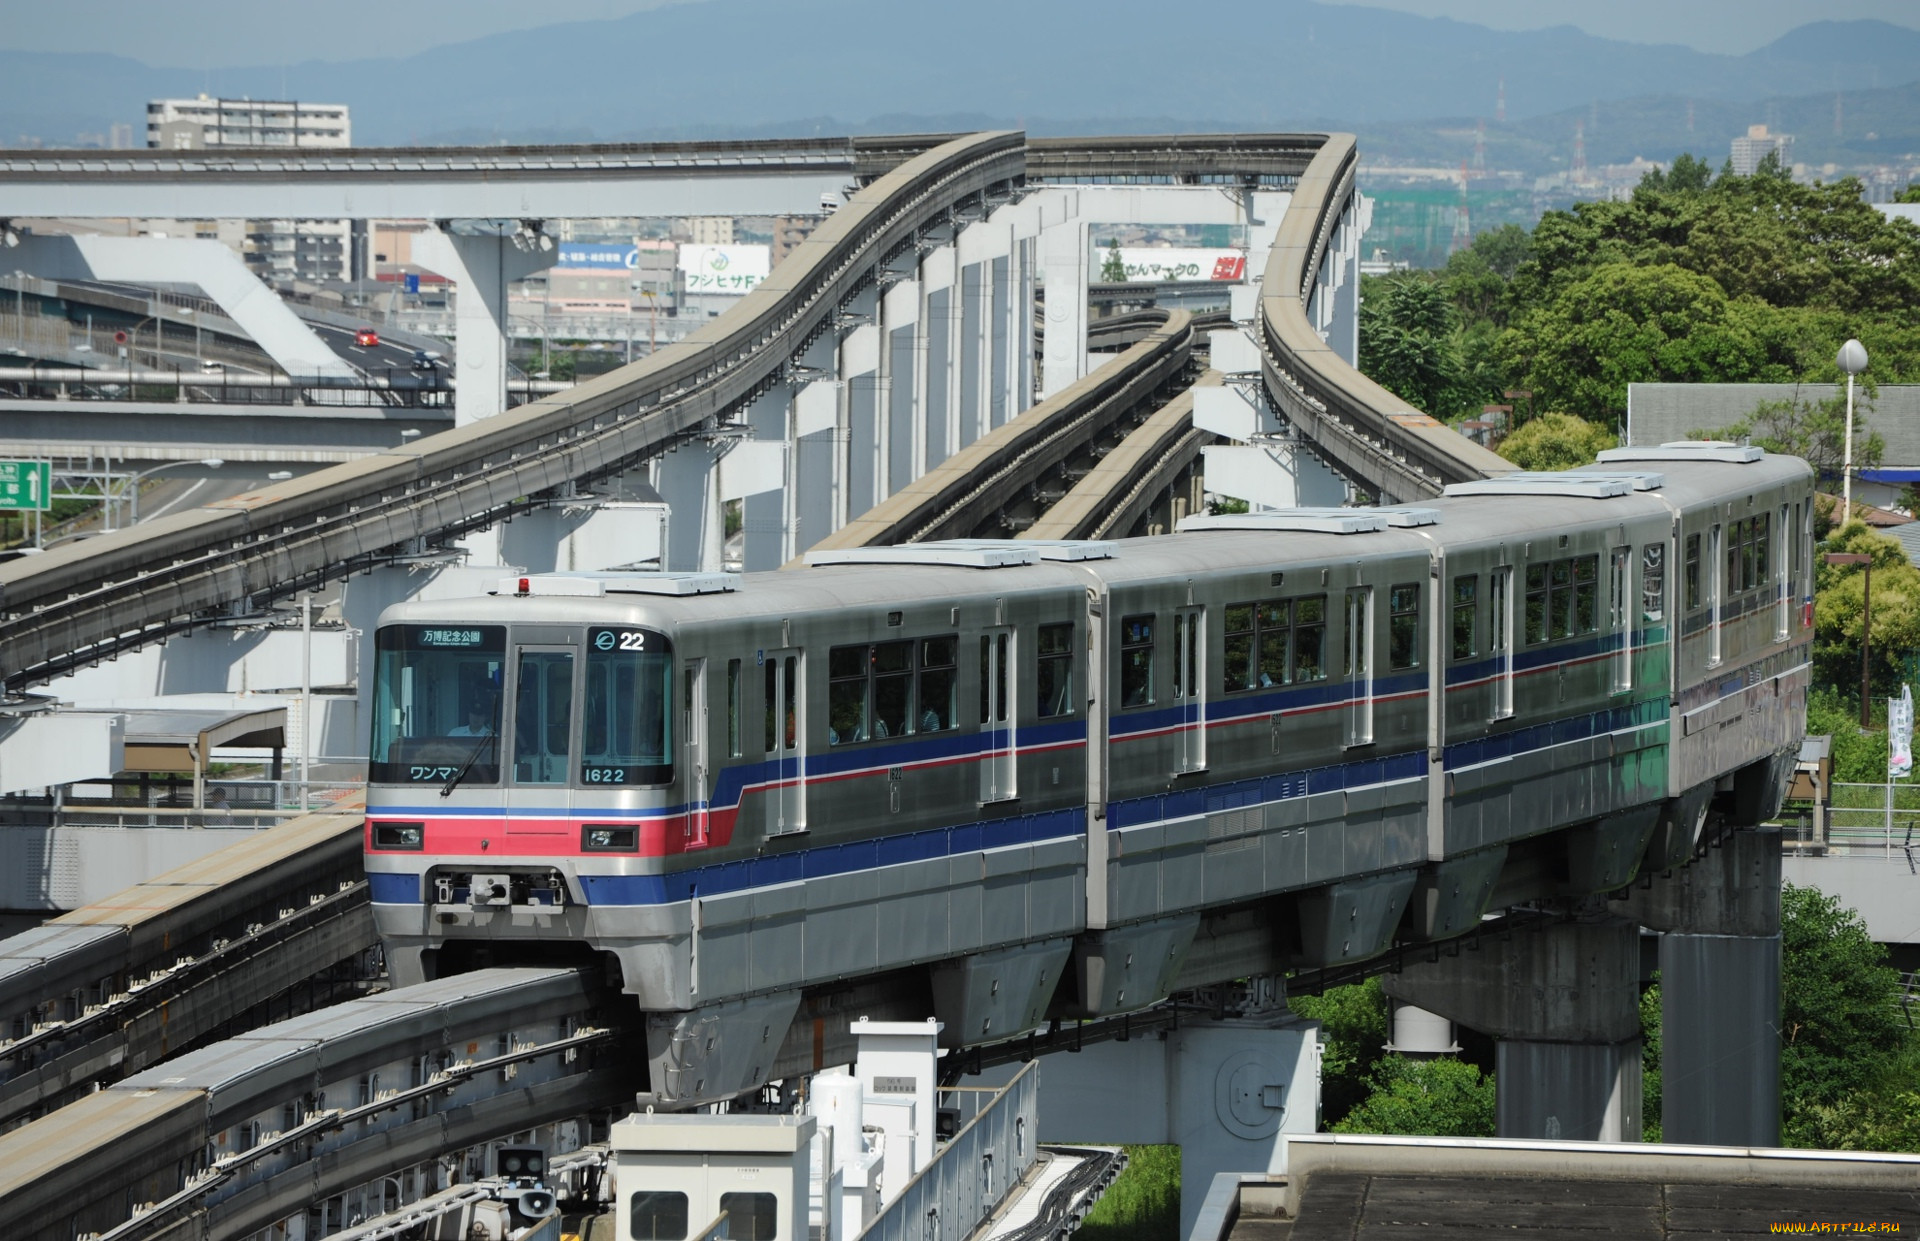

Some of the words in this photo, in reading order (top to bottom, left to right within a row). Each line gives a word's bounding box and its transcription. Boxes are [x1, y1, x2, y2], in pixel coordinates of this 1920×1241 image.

[688, 274, 766, 288] フジヒサF
[423, 630, 480, 643] 万博記念公園
[619, 631, 645, 651] 22
[585, 768, 624, 782] 1622
[889, 766, 903, 780] 1622
